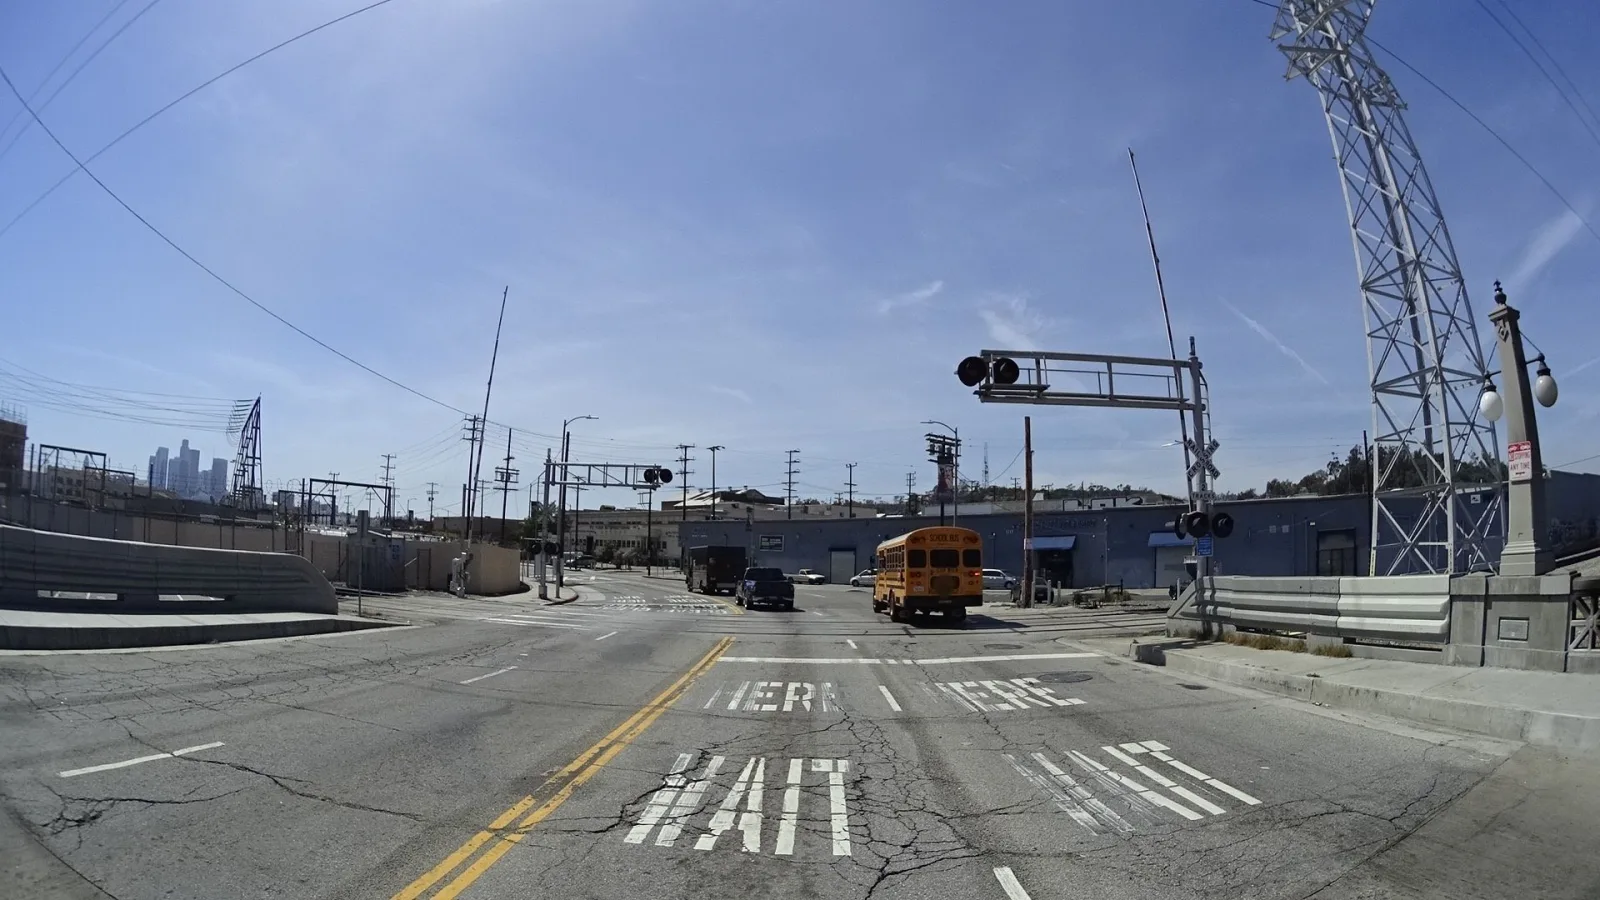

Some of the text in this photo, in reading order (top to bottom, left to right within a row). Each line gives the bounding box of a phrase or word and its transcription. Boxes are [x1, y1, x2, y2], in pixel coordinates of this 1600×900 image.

[1187, 440, 1219, 478] CROSSING
[1510, 463, 1519, 471] ANY
[1200, 483, 1206, 491] 2
[929, 533, 960, 542] SCHOOL BUS
